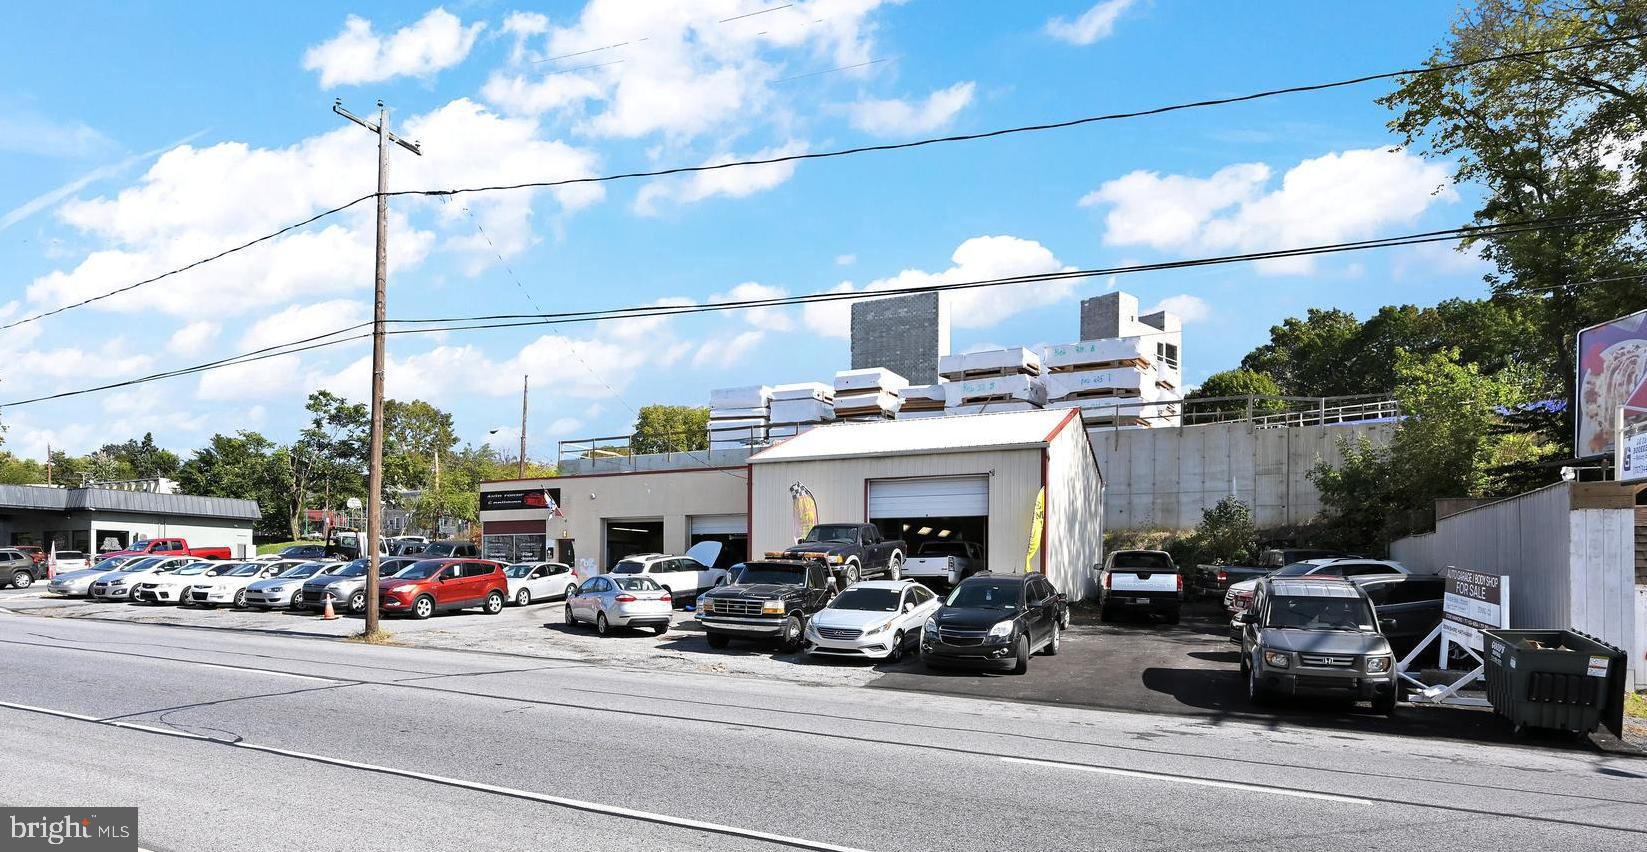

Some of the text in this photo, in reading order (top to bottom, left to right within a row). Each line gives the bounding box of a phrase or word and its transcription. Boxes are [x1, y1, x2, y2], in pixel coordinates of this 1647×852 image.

[1447, 569, 1458, 580] AUTO
[1457, 570, 1472, 583] GARAGE
[1475, 574, 1486, 585] BODY
[1485, 576, 1499, 588] SHOP
[1456, 581, 1486, 600] FOR SALE
